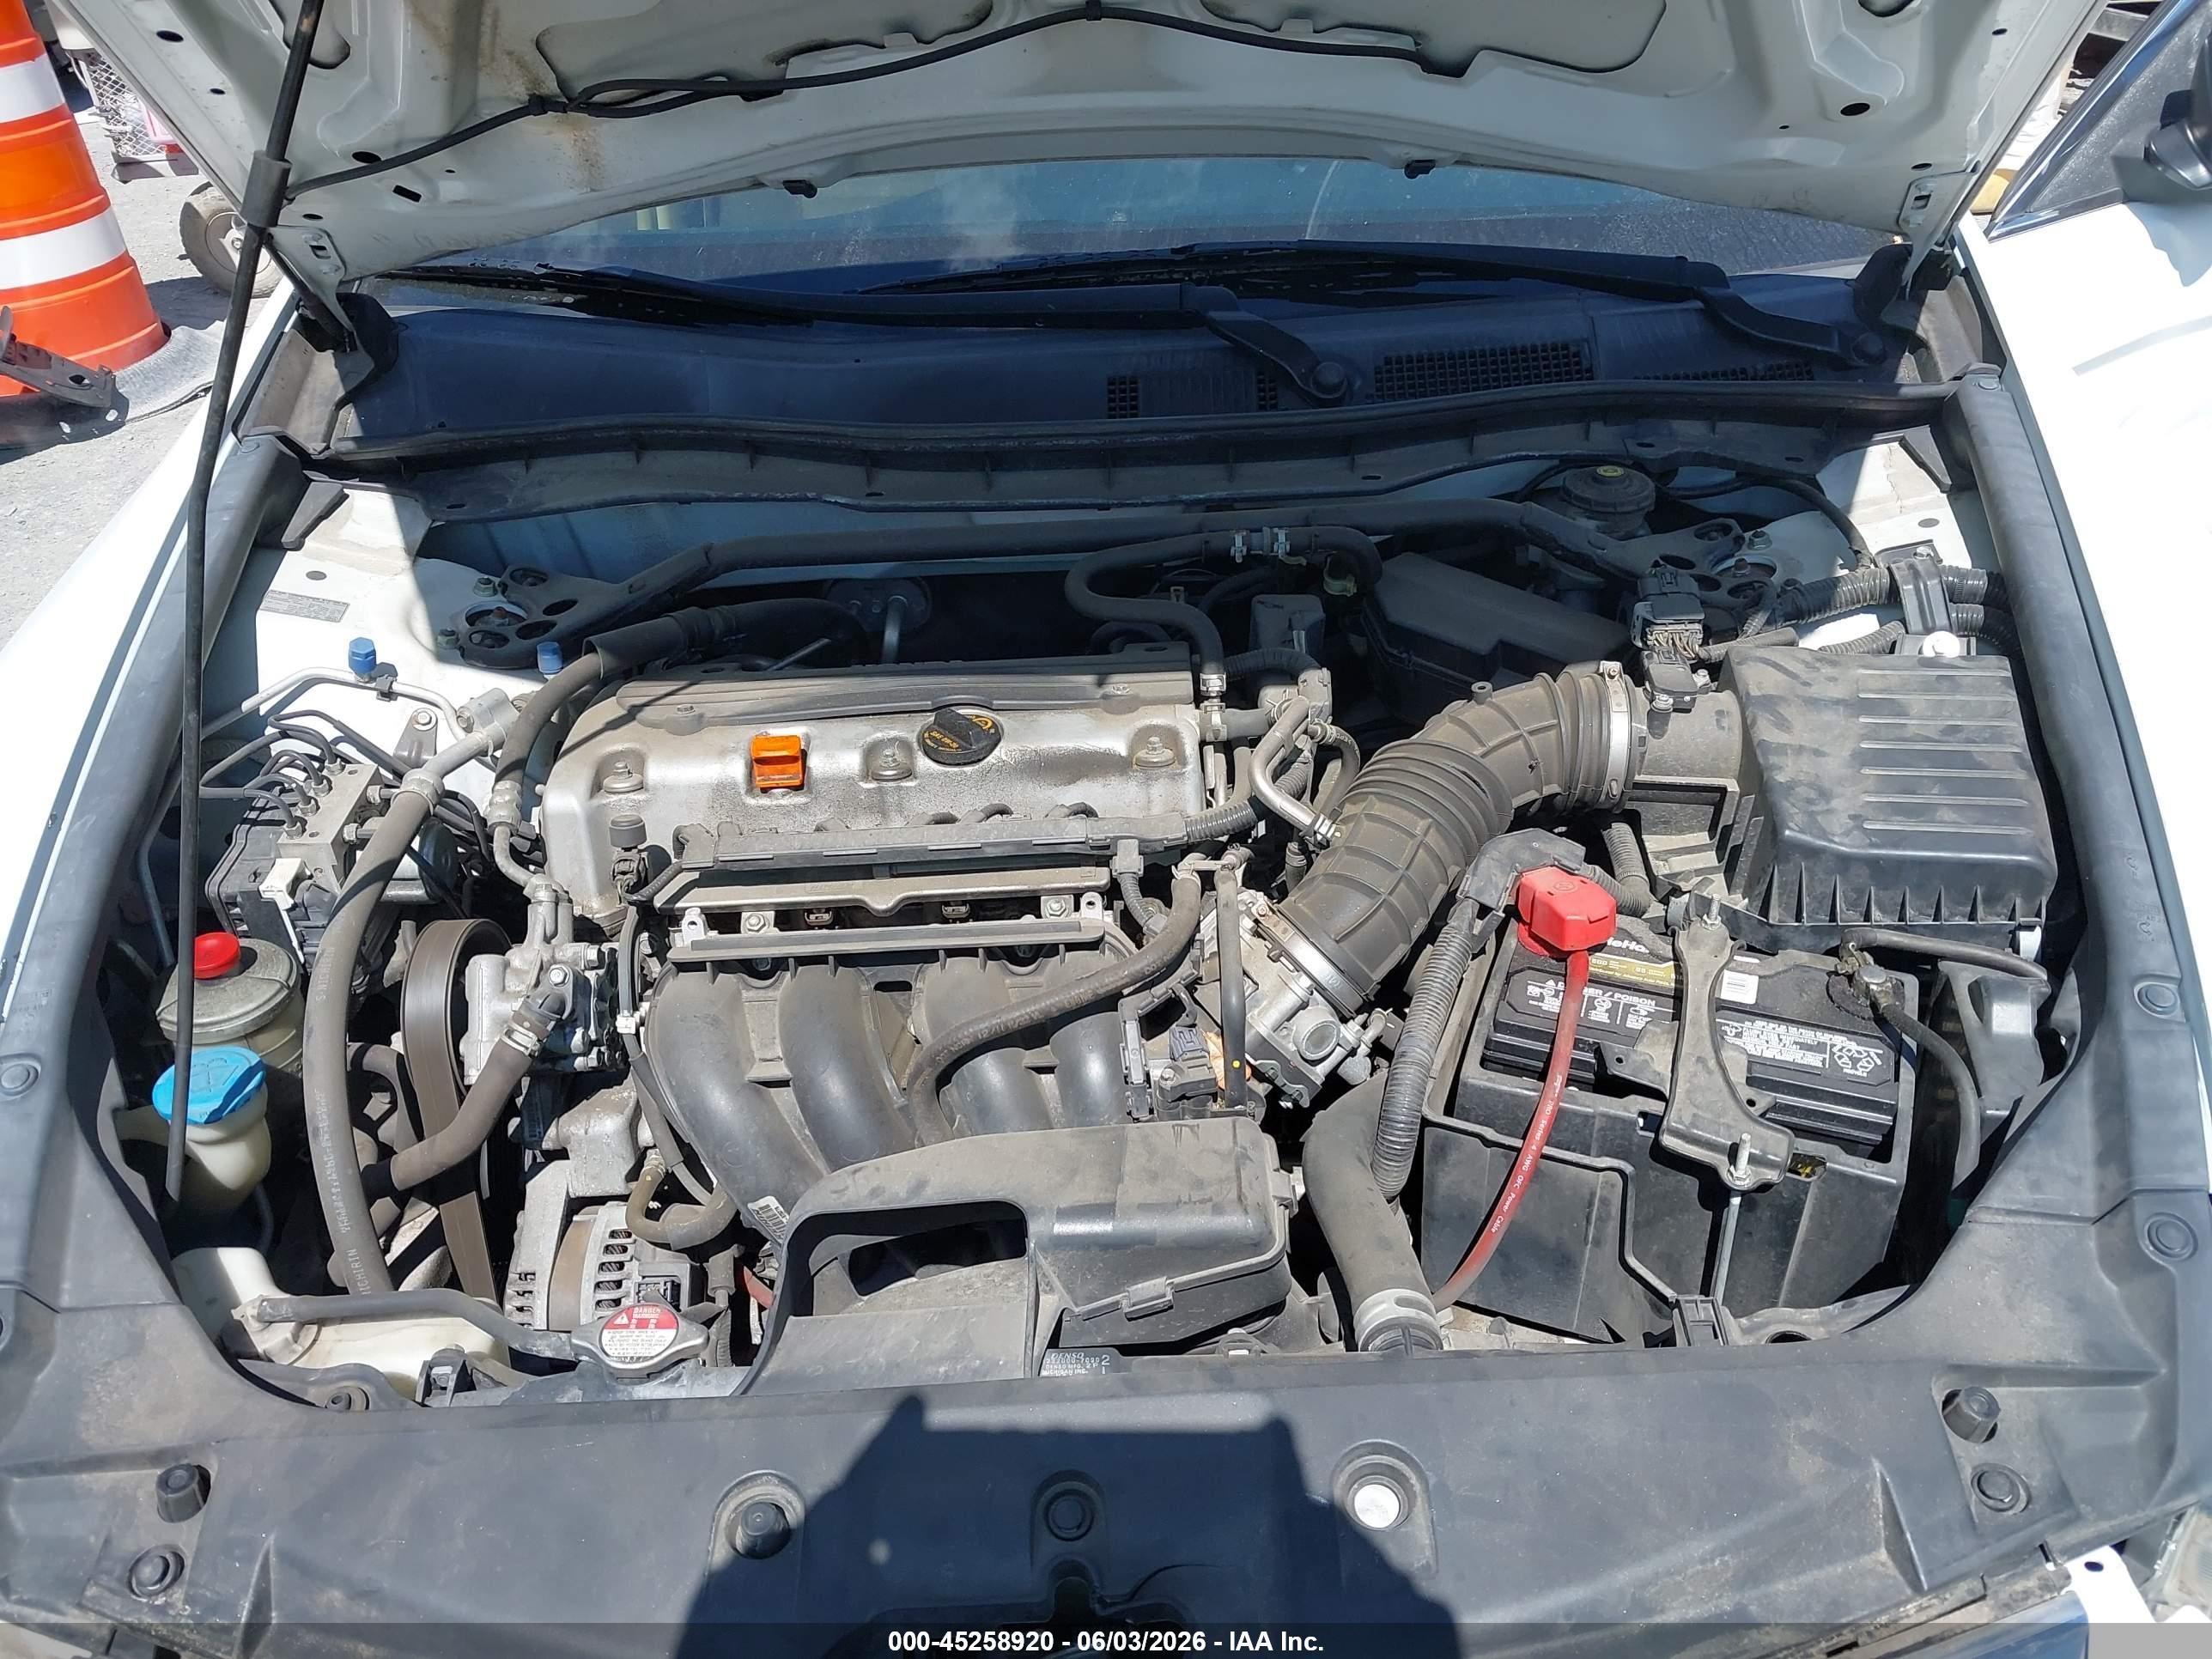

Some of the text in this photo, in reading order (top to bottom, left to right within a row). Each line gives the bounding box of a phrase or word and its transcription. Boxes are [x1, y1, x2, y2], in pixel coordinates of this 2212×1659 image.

[1613, 992, 1656, 1007] POISON
[1522, 1153, 1533, 1171] AWG
[1513, 1175, 1524, 1189] OFC
[1503, 1192, 1516, 1212] Power
[1491, 1215, 1504, 1233] Cable
[1102, 1354, 1110, 1365] 2
